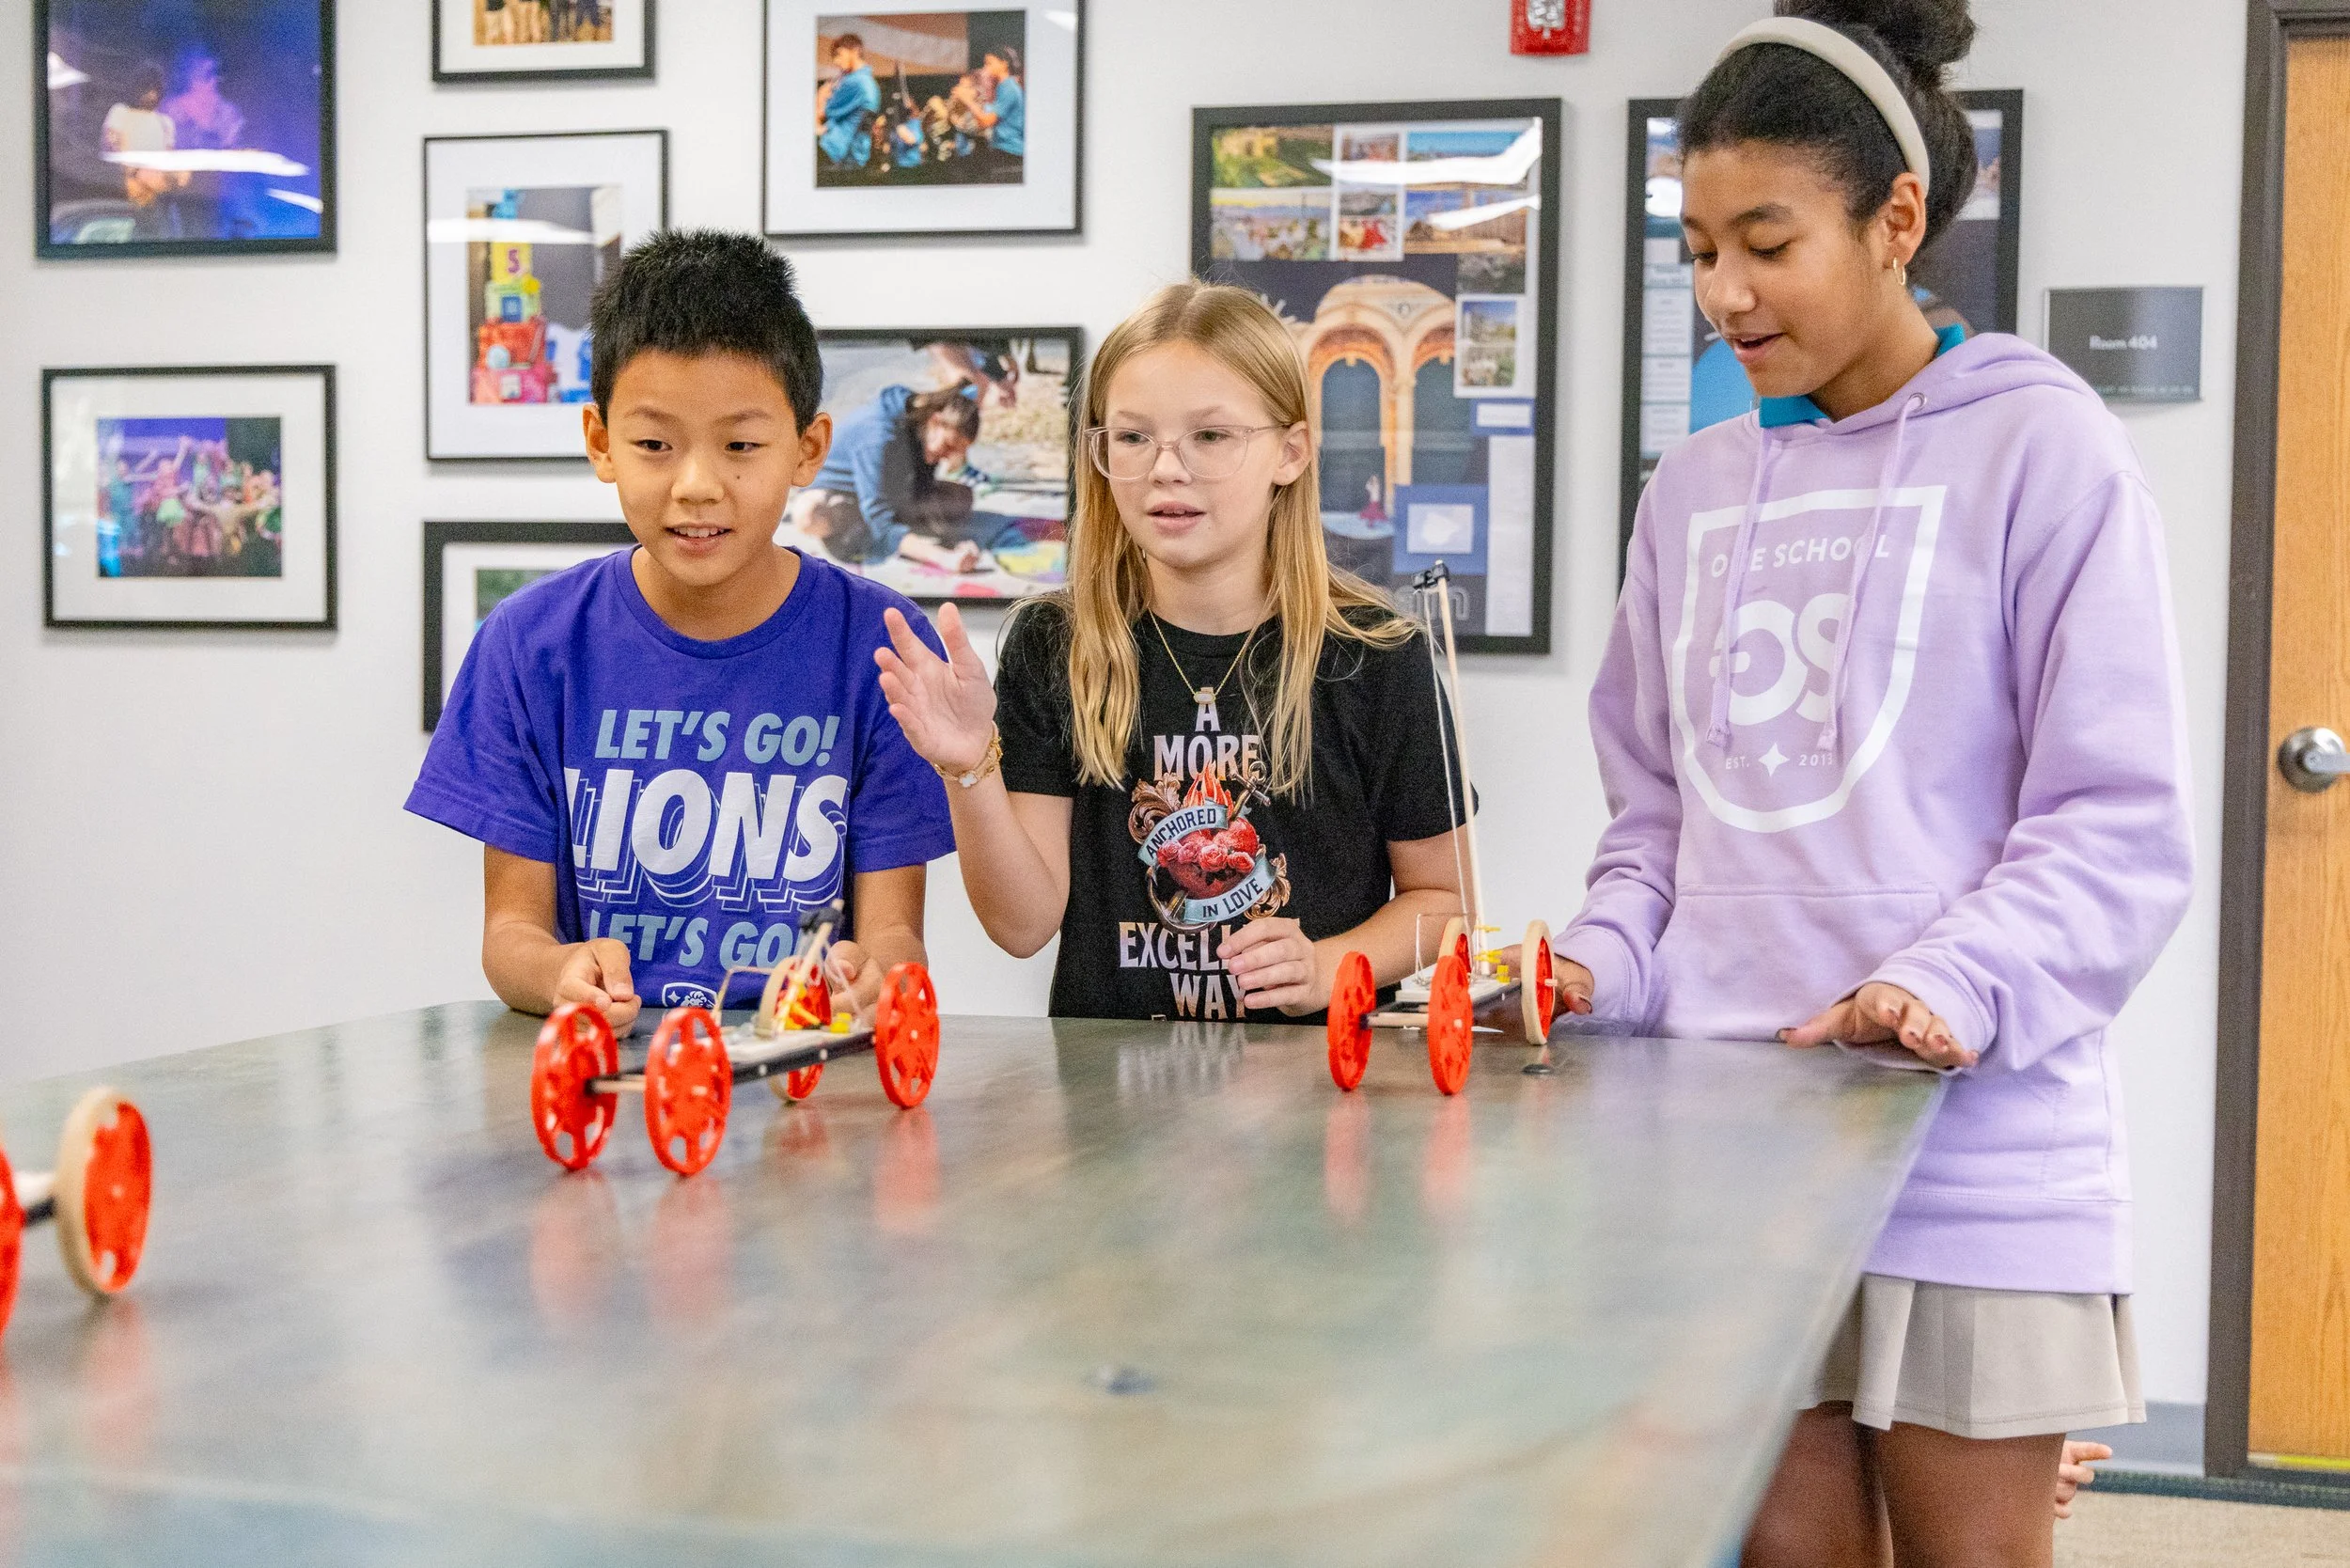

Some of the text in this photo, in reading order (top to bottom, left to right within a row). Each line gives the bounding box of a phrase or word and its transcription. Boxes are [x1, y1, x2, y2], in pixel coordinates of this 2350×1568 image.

[2128, 335, 2158, 350] 404
[1711, 535, 1889, 579] OE SCHOL
[594, 709, 840, 767] LET'S GO!
[1195, 702, 1221, 732] A
[1153, 734, 1261, 782] MORE
[1725, 753, 1834, 770] EST. 2013
[564, 767, 849, 906] IONS
[1146, 808, 1217, 860] ANCHORED
[1202, 877, 1263, 918] IN LOVE
[719, 919, 816, 972] GO
[1119, 917, 1301, 971] EXCEL
[1169, 972, 1246, 1020] WAY
